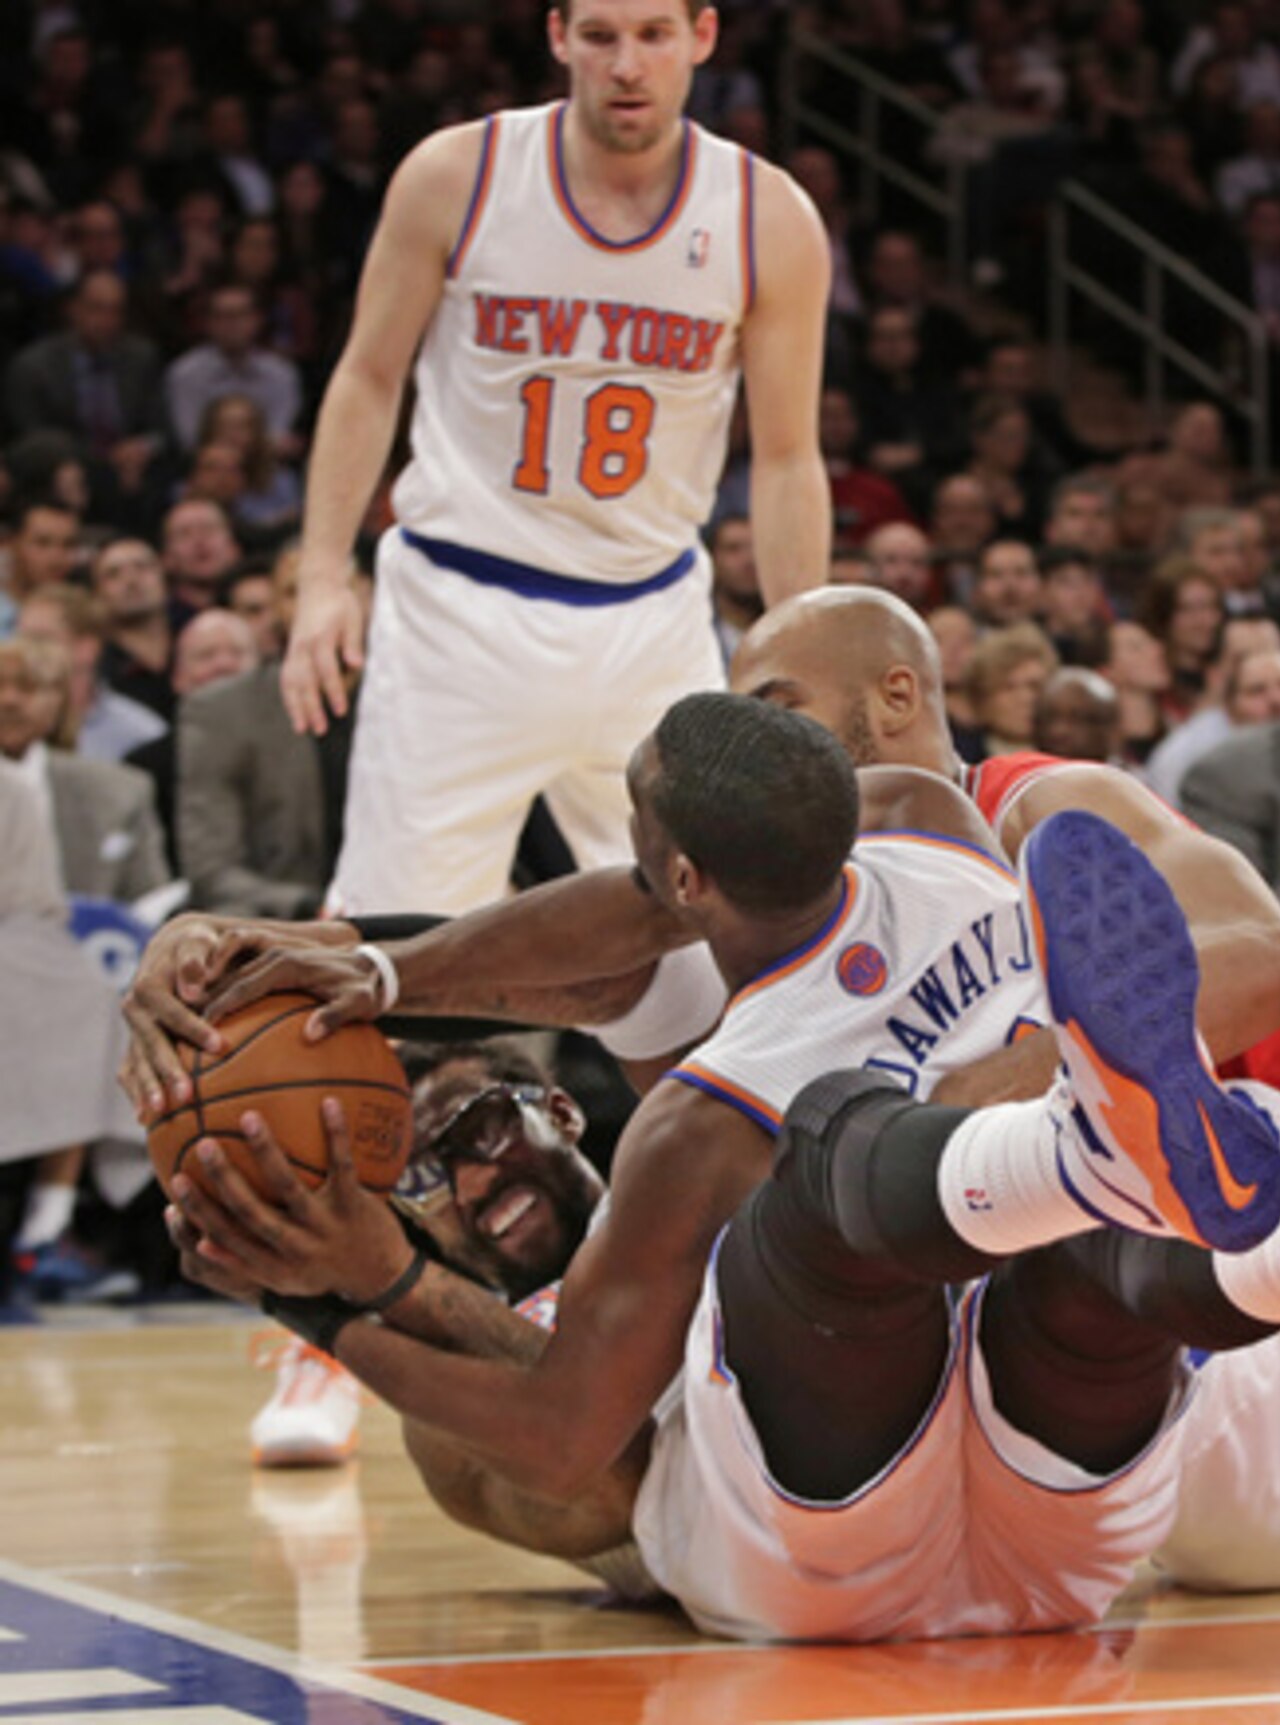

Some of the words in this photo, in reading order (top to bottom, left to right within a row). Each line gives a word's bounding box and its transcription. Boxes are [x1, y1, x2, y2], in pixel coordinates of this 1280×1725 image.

[473, 292, 589, 357] NEW
[596, 301, 726, 373] YORK
[511, 373, 657, 501] 18
